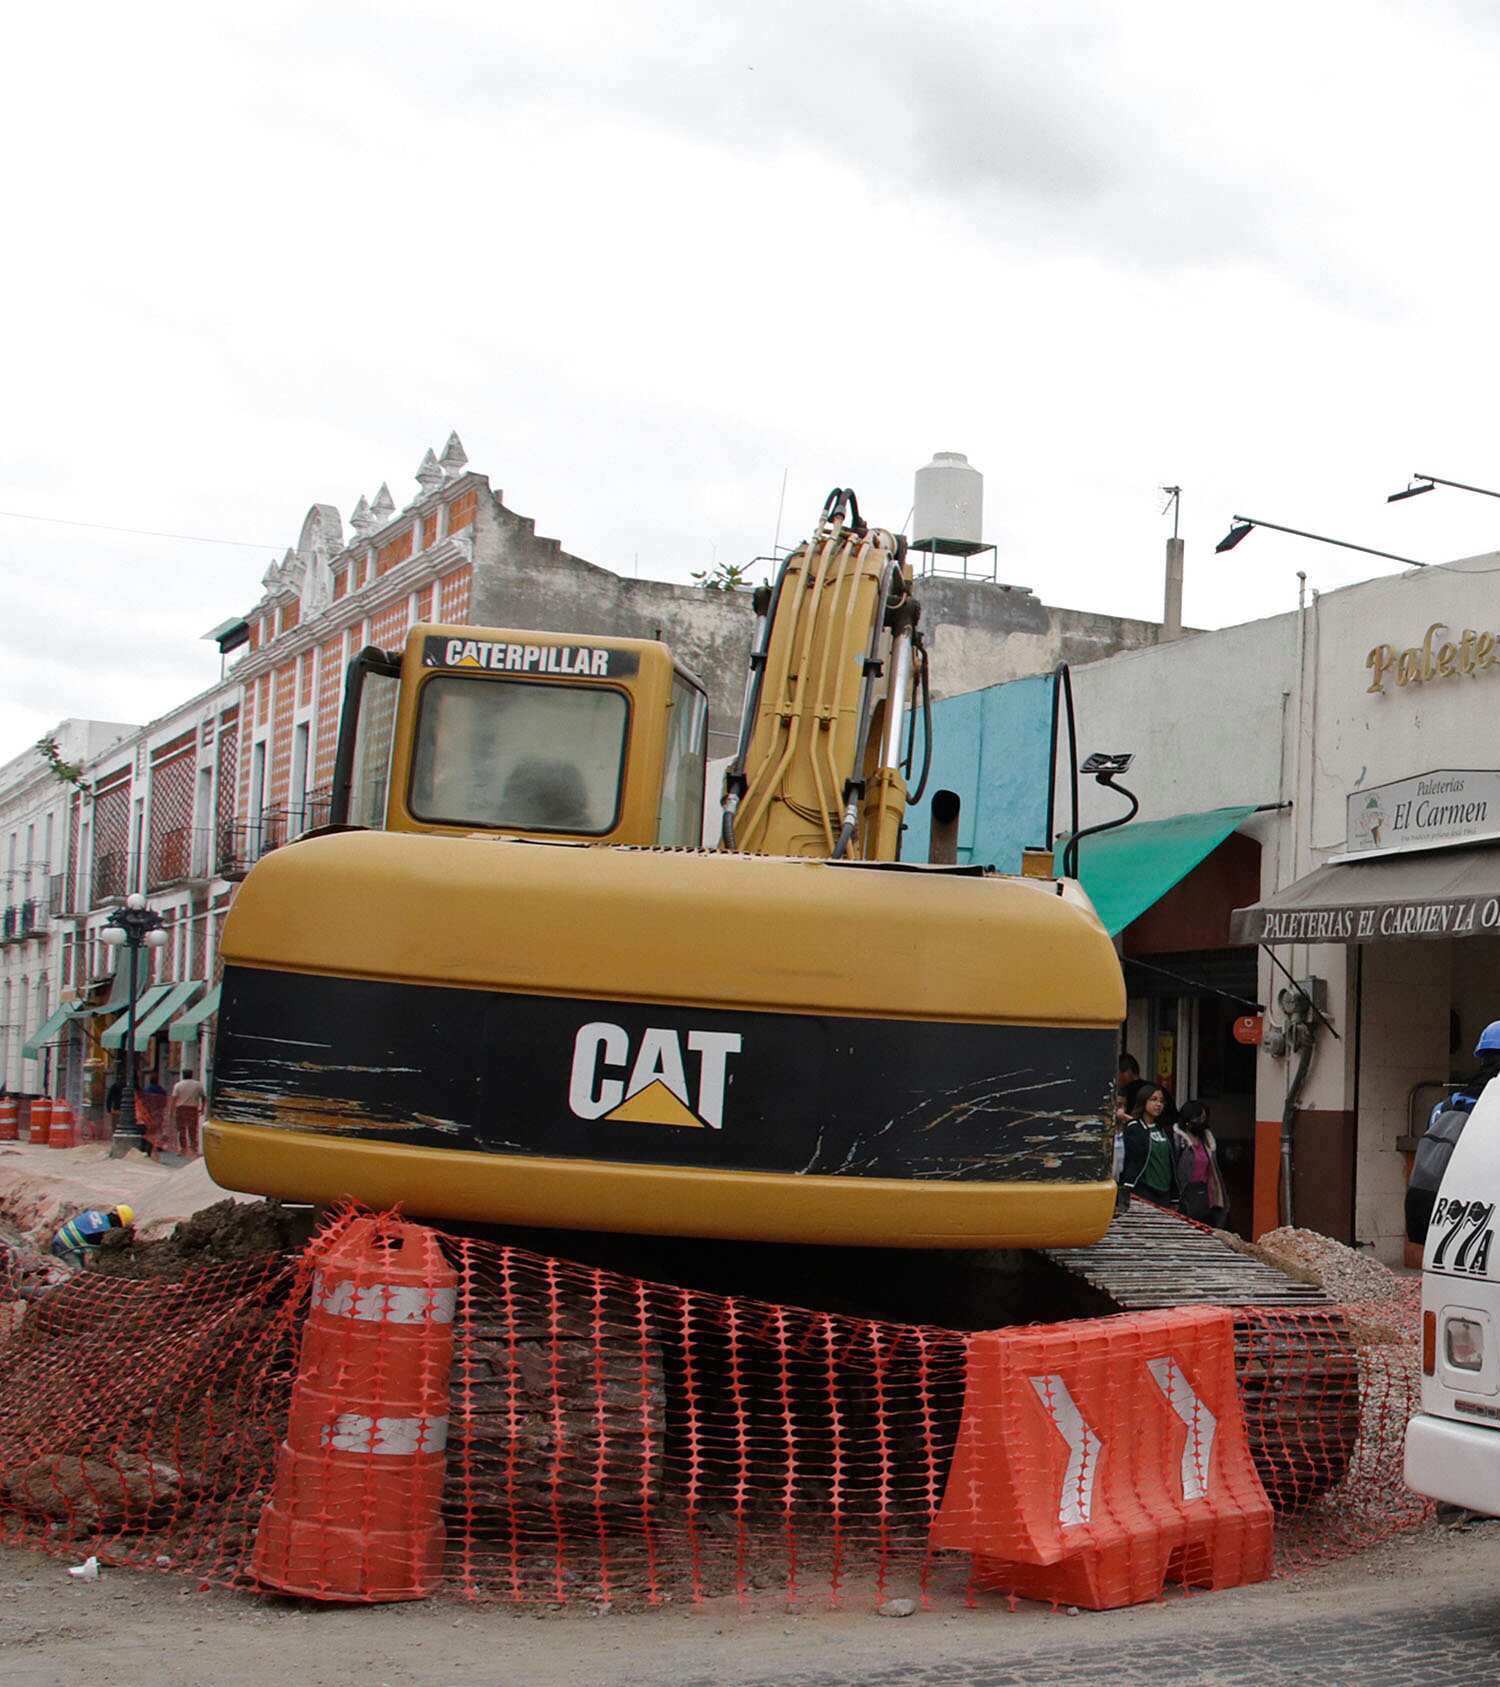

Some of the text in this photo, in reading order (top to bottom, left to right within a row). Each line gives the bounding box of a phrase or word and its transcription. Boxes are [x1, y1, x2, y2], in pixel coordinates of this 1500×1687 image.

[446, 640, 609, 676] CATERPILLAR
[1393, 800, 1488, 831] El Carmen
[1261, 910, 1354, 939] PALETERIAS
[1357, 910, 1375, 937] EL
[1380, 904, 1453, 936] CARMEN
[1452, 903, 1477, 932] LA
[569, 1021, 742, 1130] CAT
